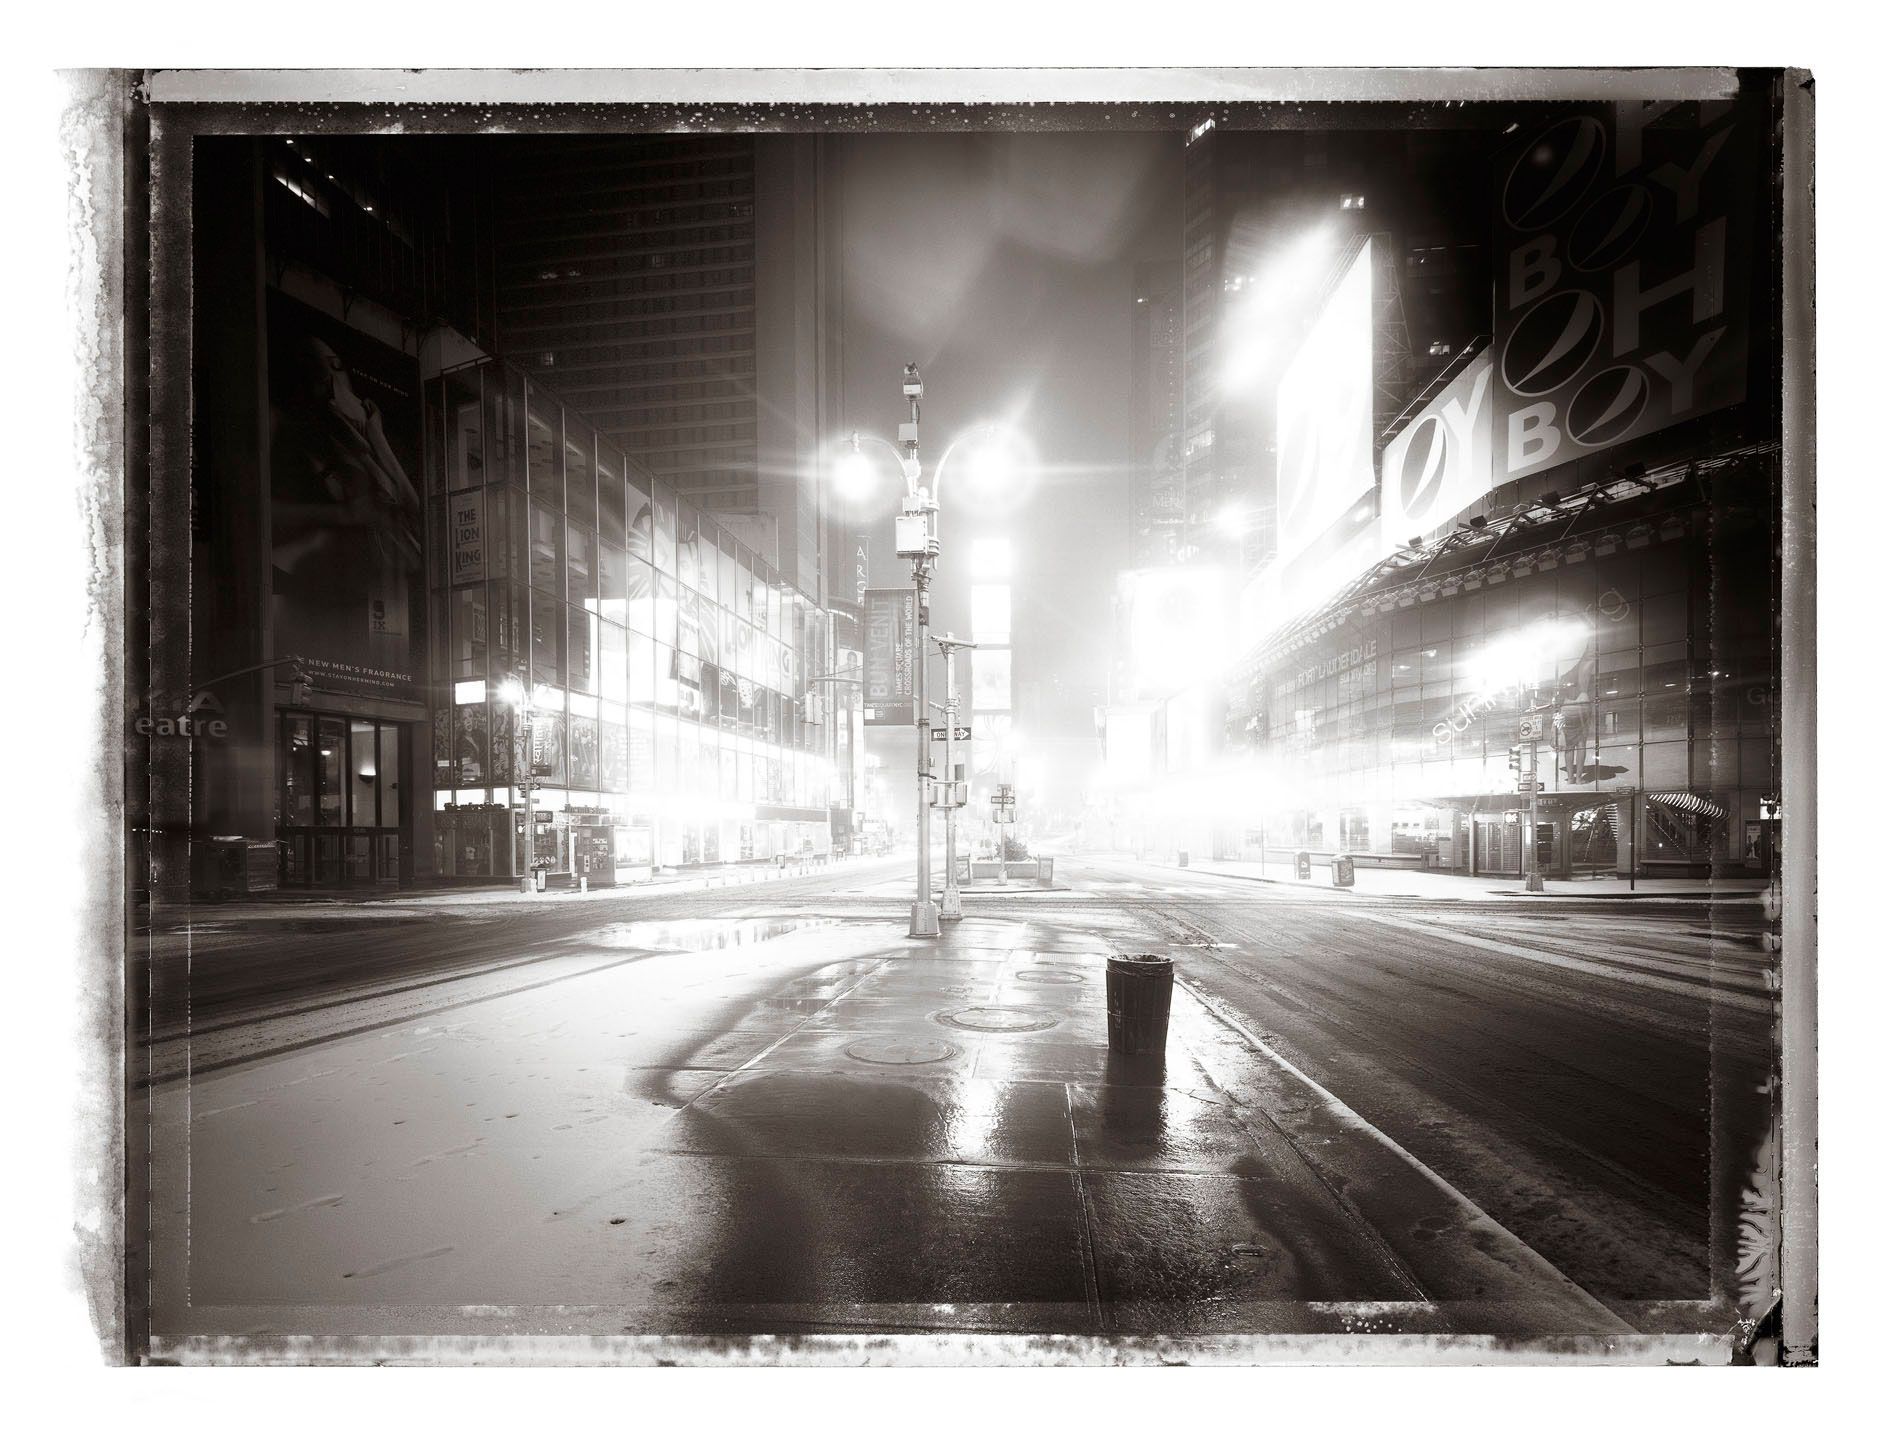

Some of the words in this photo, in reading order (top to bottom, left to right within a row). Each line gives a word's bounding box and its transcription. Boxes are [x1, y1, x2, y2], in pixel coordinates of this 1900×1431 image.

[457, 508, 477, 523] THE
[455, 527, 480, 549] LION
[904, 595, 913, 621] WORLD
[904, 622, 913, 636] THE
[308, 658, 330, 668] NEW
[332, 663, 361, 673] MEN'S
[362, 667, 412, 682] FRAGRANCE
[904, 648, 913, 696] CROSSROADS
[895, 672, 904, 696] TIMES
